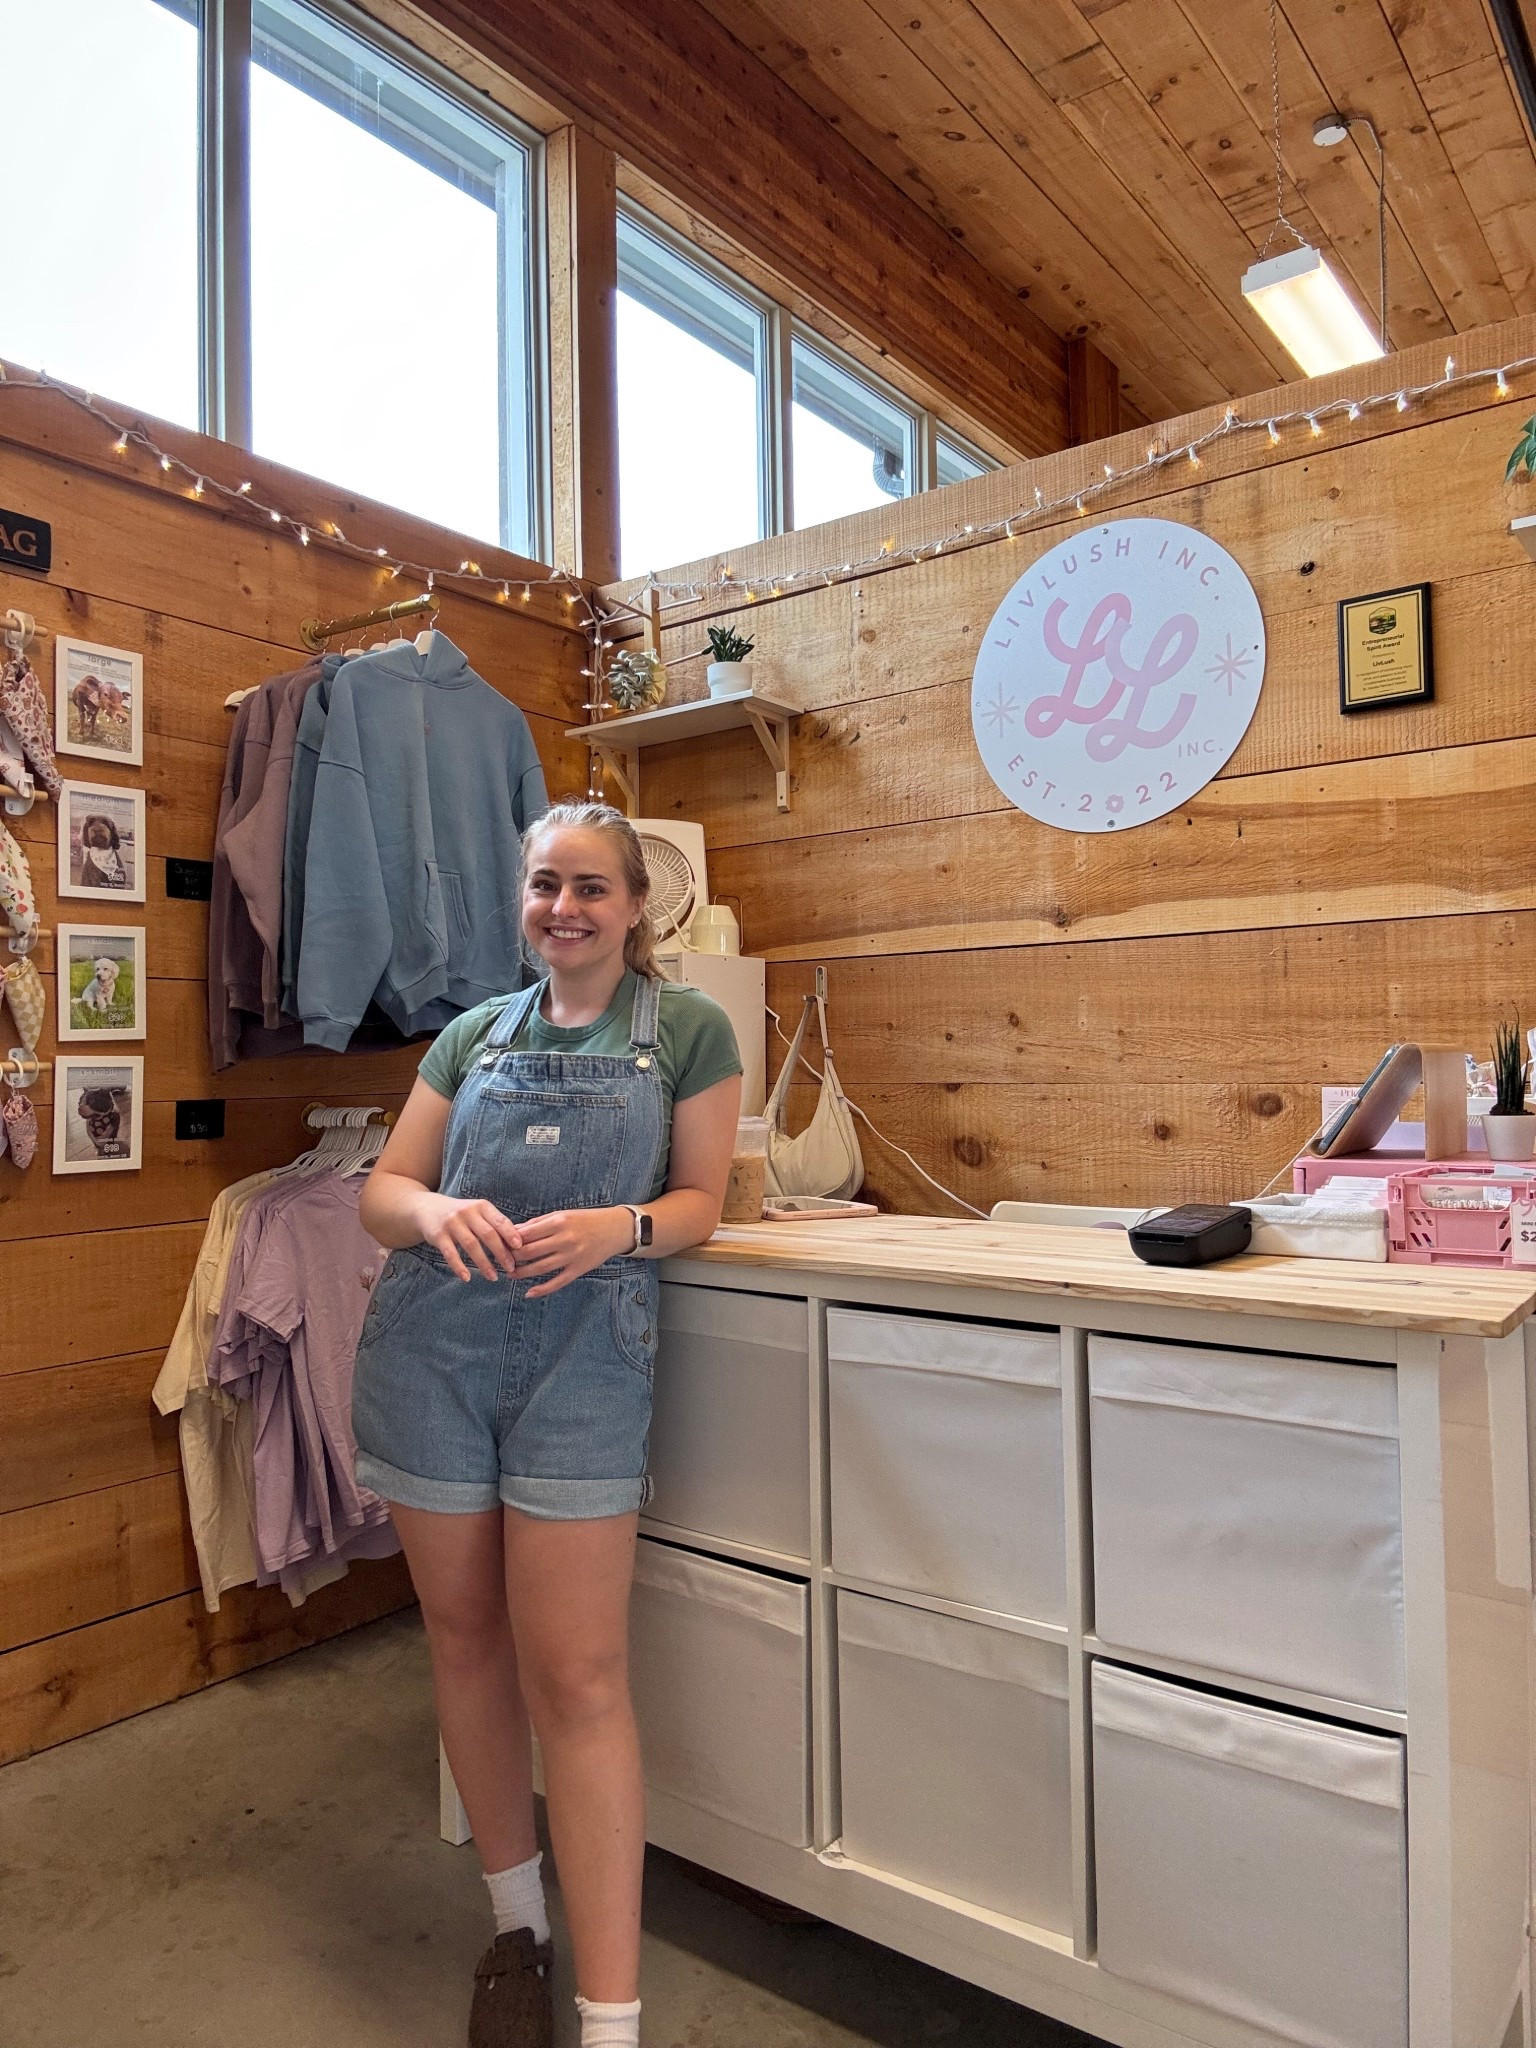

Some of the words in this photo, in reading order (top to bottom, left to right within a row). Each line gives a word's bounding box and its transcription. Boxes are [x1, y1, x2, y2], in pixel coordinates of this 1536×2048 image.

[994, 537, 1132, 650] LIVLUSH
[1157, 540, 1222, 601] INC.
[1361, 633, 1405, 646] Entrepreneurial
[1366, 644, 1382, 652] Spirit
[87, 654, 112, 667] large
[1178, 738, 1224, 759] INC.
